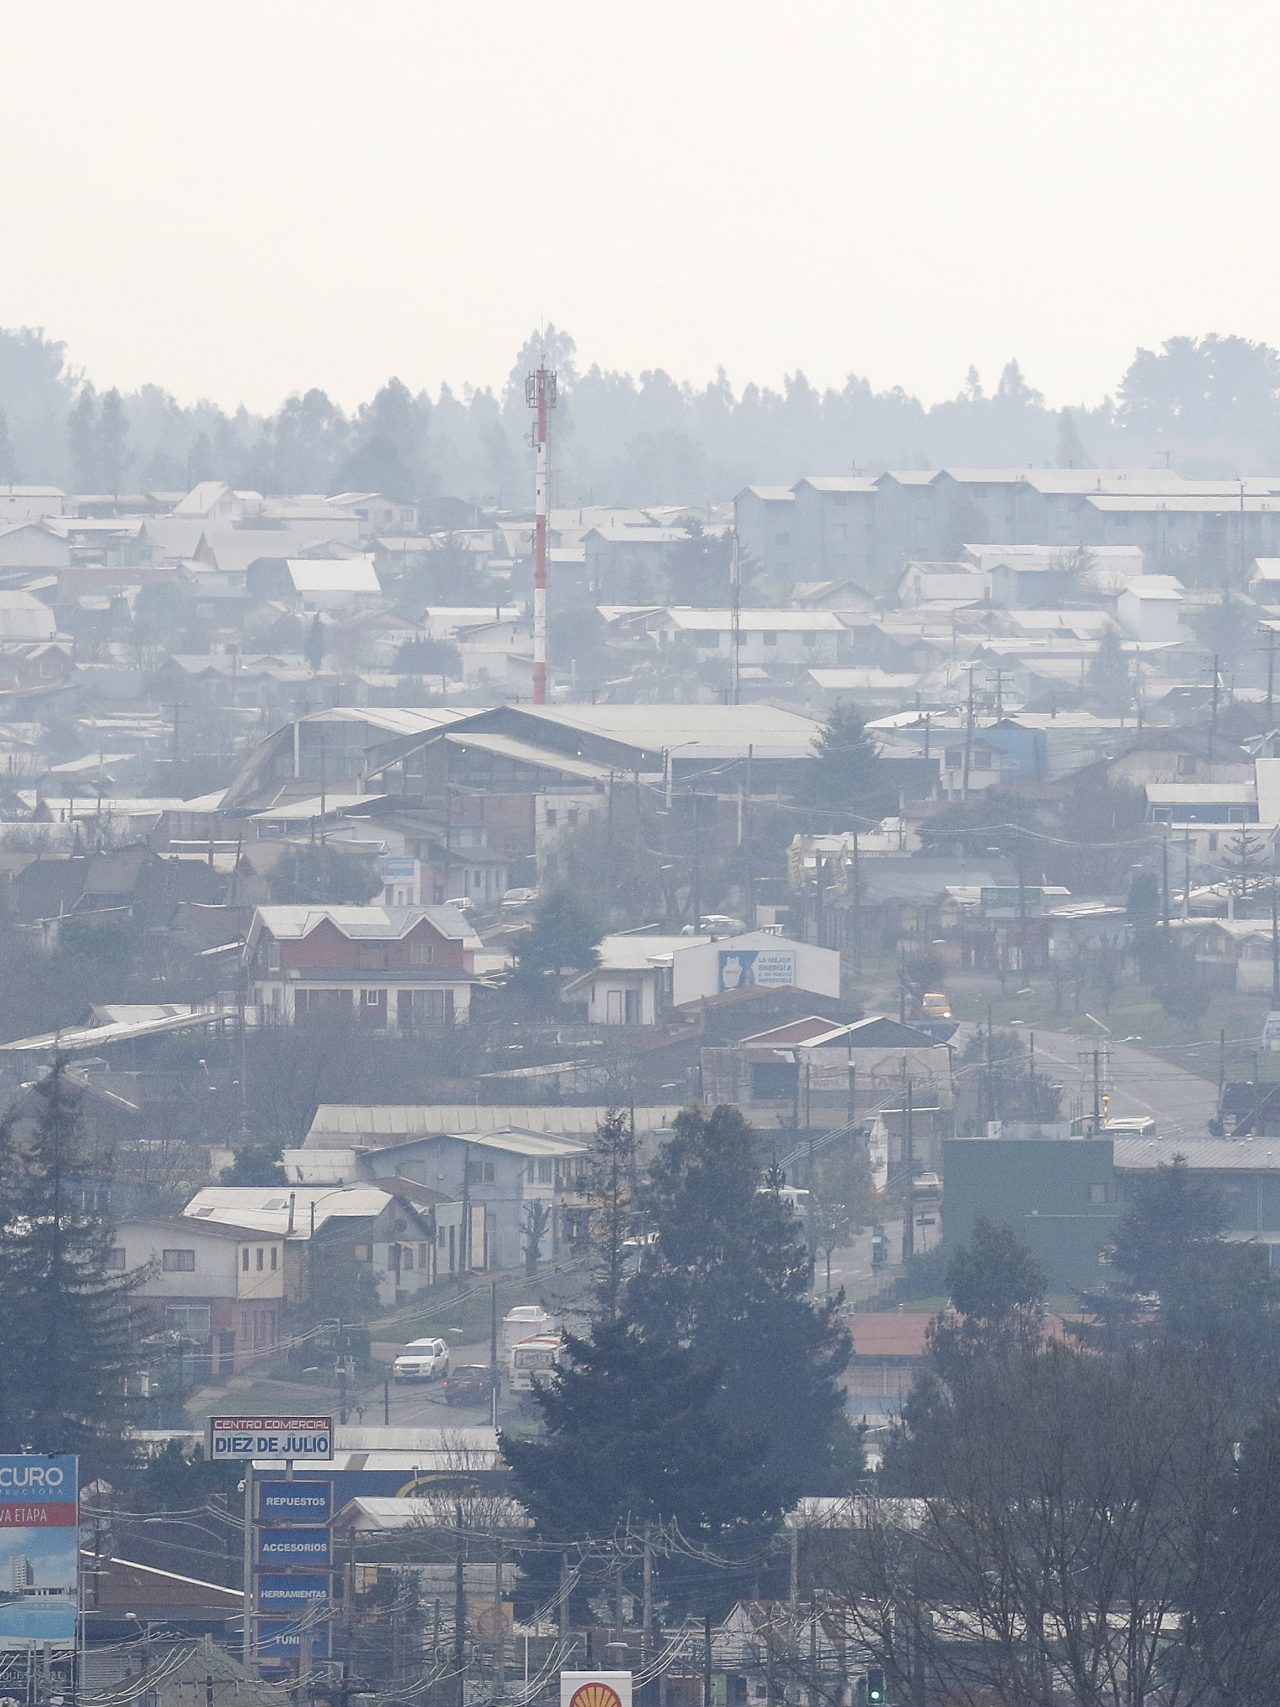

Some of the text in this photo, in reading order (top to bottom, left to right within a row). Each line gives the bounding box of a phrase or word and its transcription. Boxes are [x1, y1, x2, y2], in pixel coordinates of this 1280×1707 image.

[214, 1420, 329, 1430] CENTRO COMERCIAL
[215, 1437, 329, 1453] DIEZ DE JULIO
[266, 1497, 326, 1506] REPUESTOS
[15, 1508, 48, 1522] ETAPA
[262, 1543, 328, 1552] ACCESORIOS
[261, 1590, 327, 1599] HERRAMIENTAS
[276, 1635, 300, 1645] TUNI
